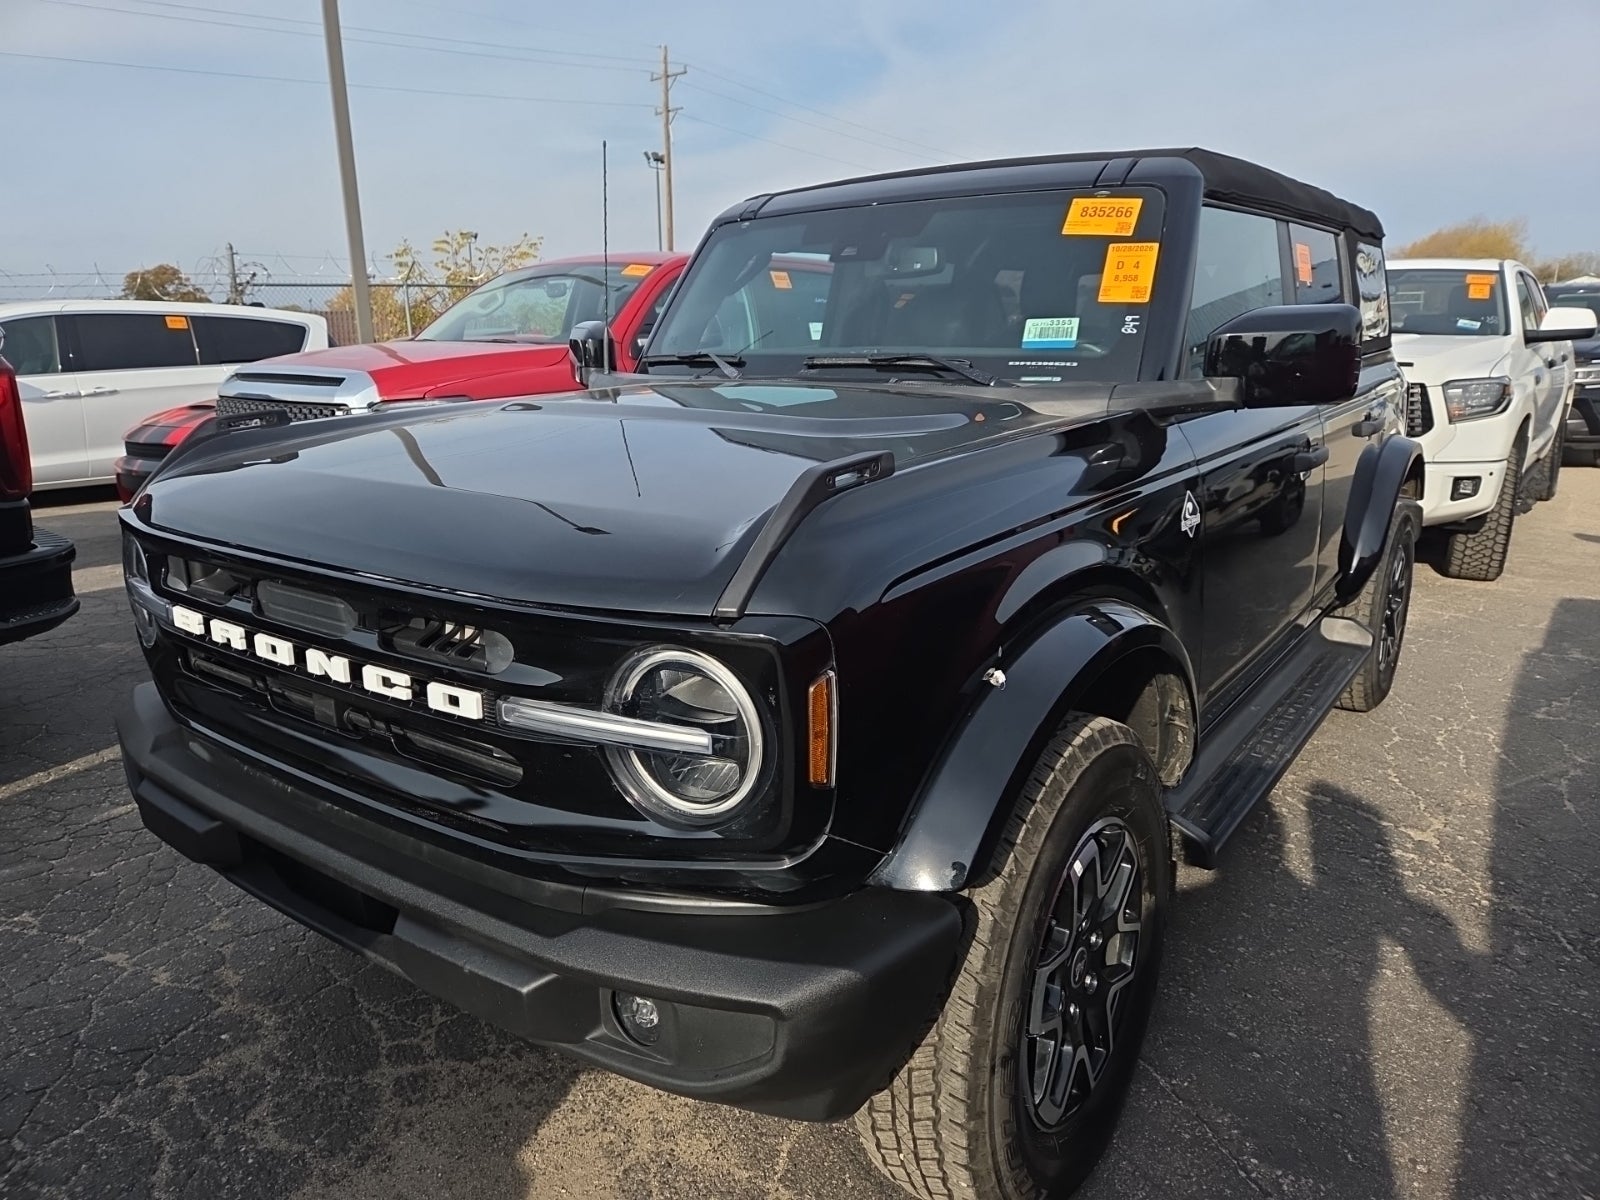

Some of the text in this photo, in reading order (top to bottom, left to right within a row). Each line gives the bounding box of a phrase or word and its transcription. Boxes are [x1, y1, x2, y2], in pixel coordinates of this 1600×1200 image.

[1080, 206, 1134, 218] 835266
[1116, 260, 1140, 270] D 4
[1113, 274, 1139, 282] 8,958
[1120, 315, 1141, 334] 849
[172, 604, 484, 721] BRONCO
